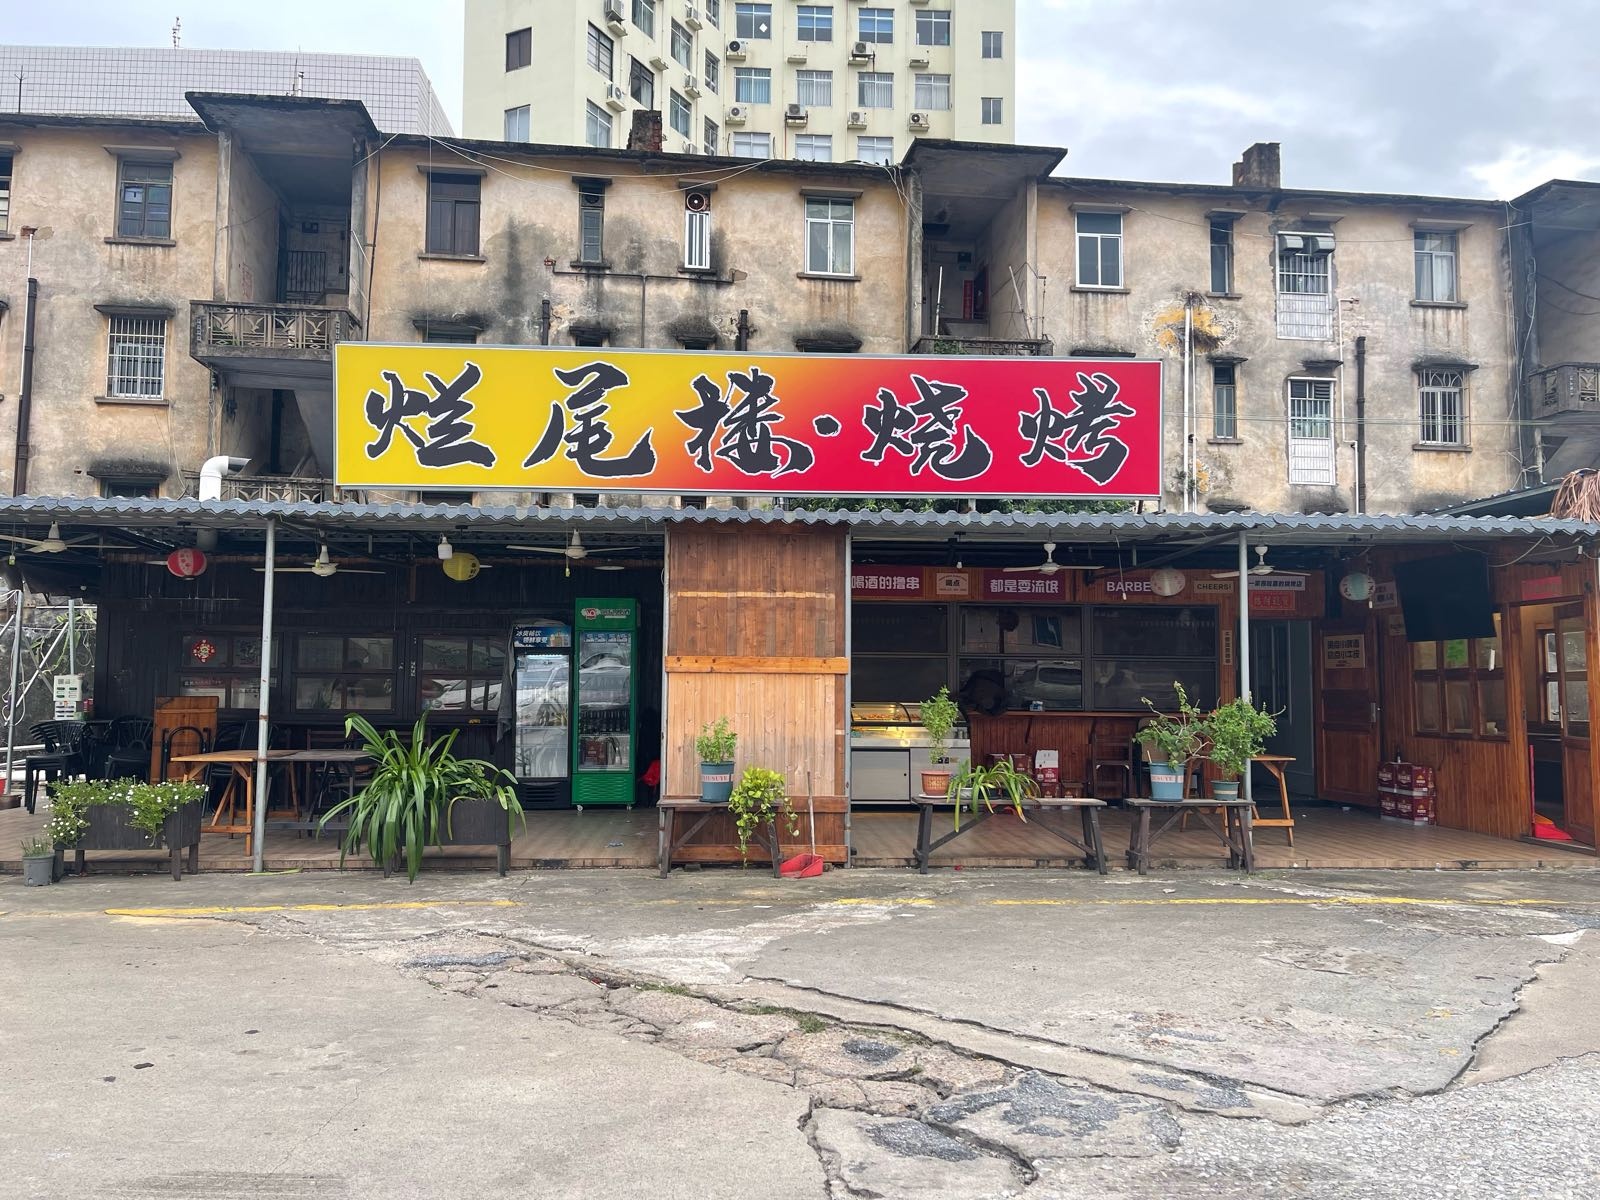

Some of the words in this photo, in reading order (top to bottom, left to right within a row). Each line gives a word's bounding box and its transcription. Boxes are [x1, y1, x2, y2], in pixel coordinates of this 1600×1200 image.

[364, 361, 1137, 485] 烂尾楼·烧烤
[851, 575, 920, 590] 喝酒的撸串
[990, 579, 1059, 593] 都是耍流氓
[1106, 581, 1152, 592] BARBE
